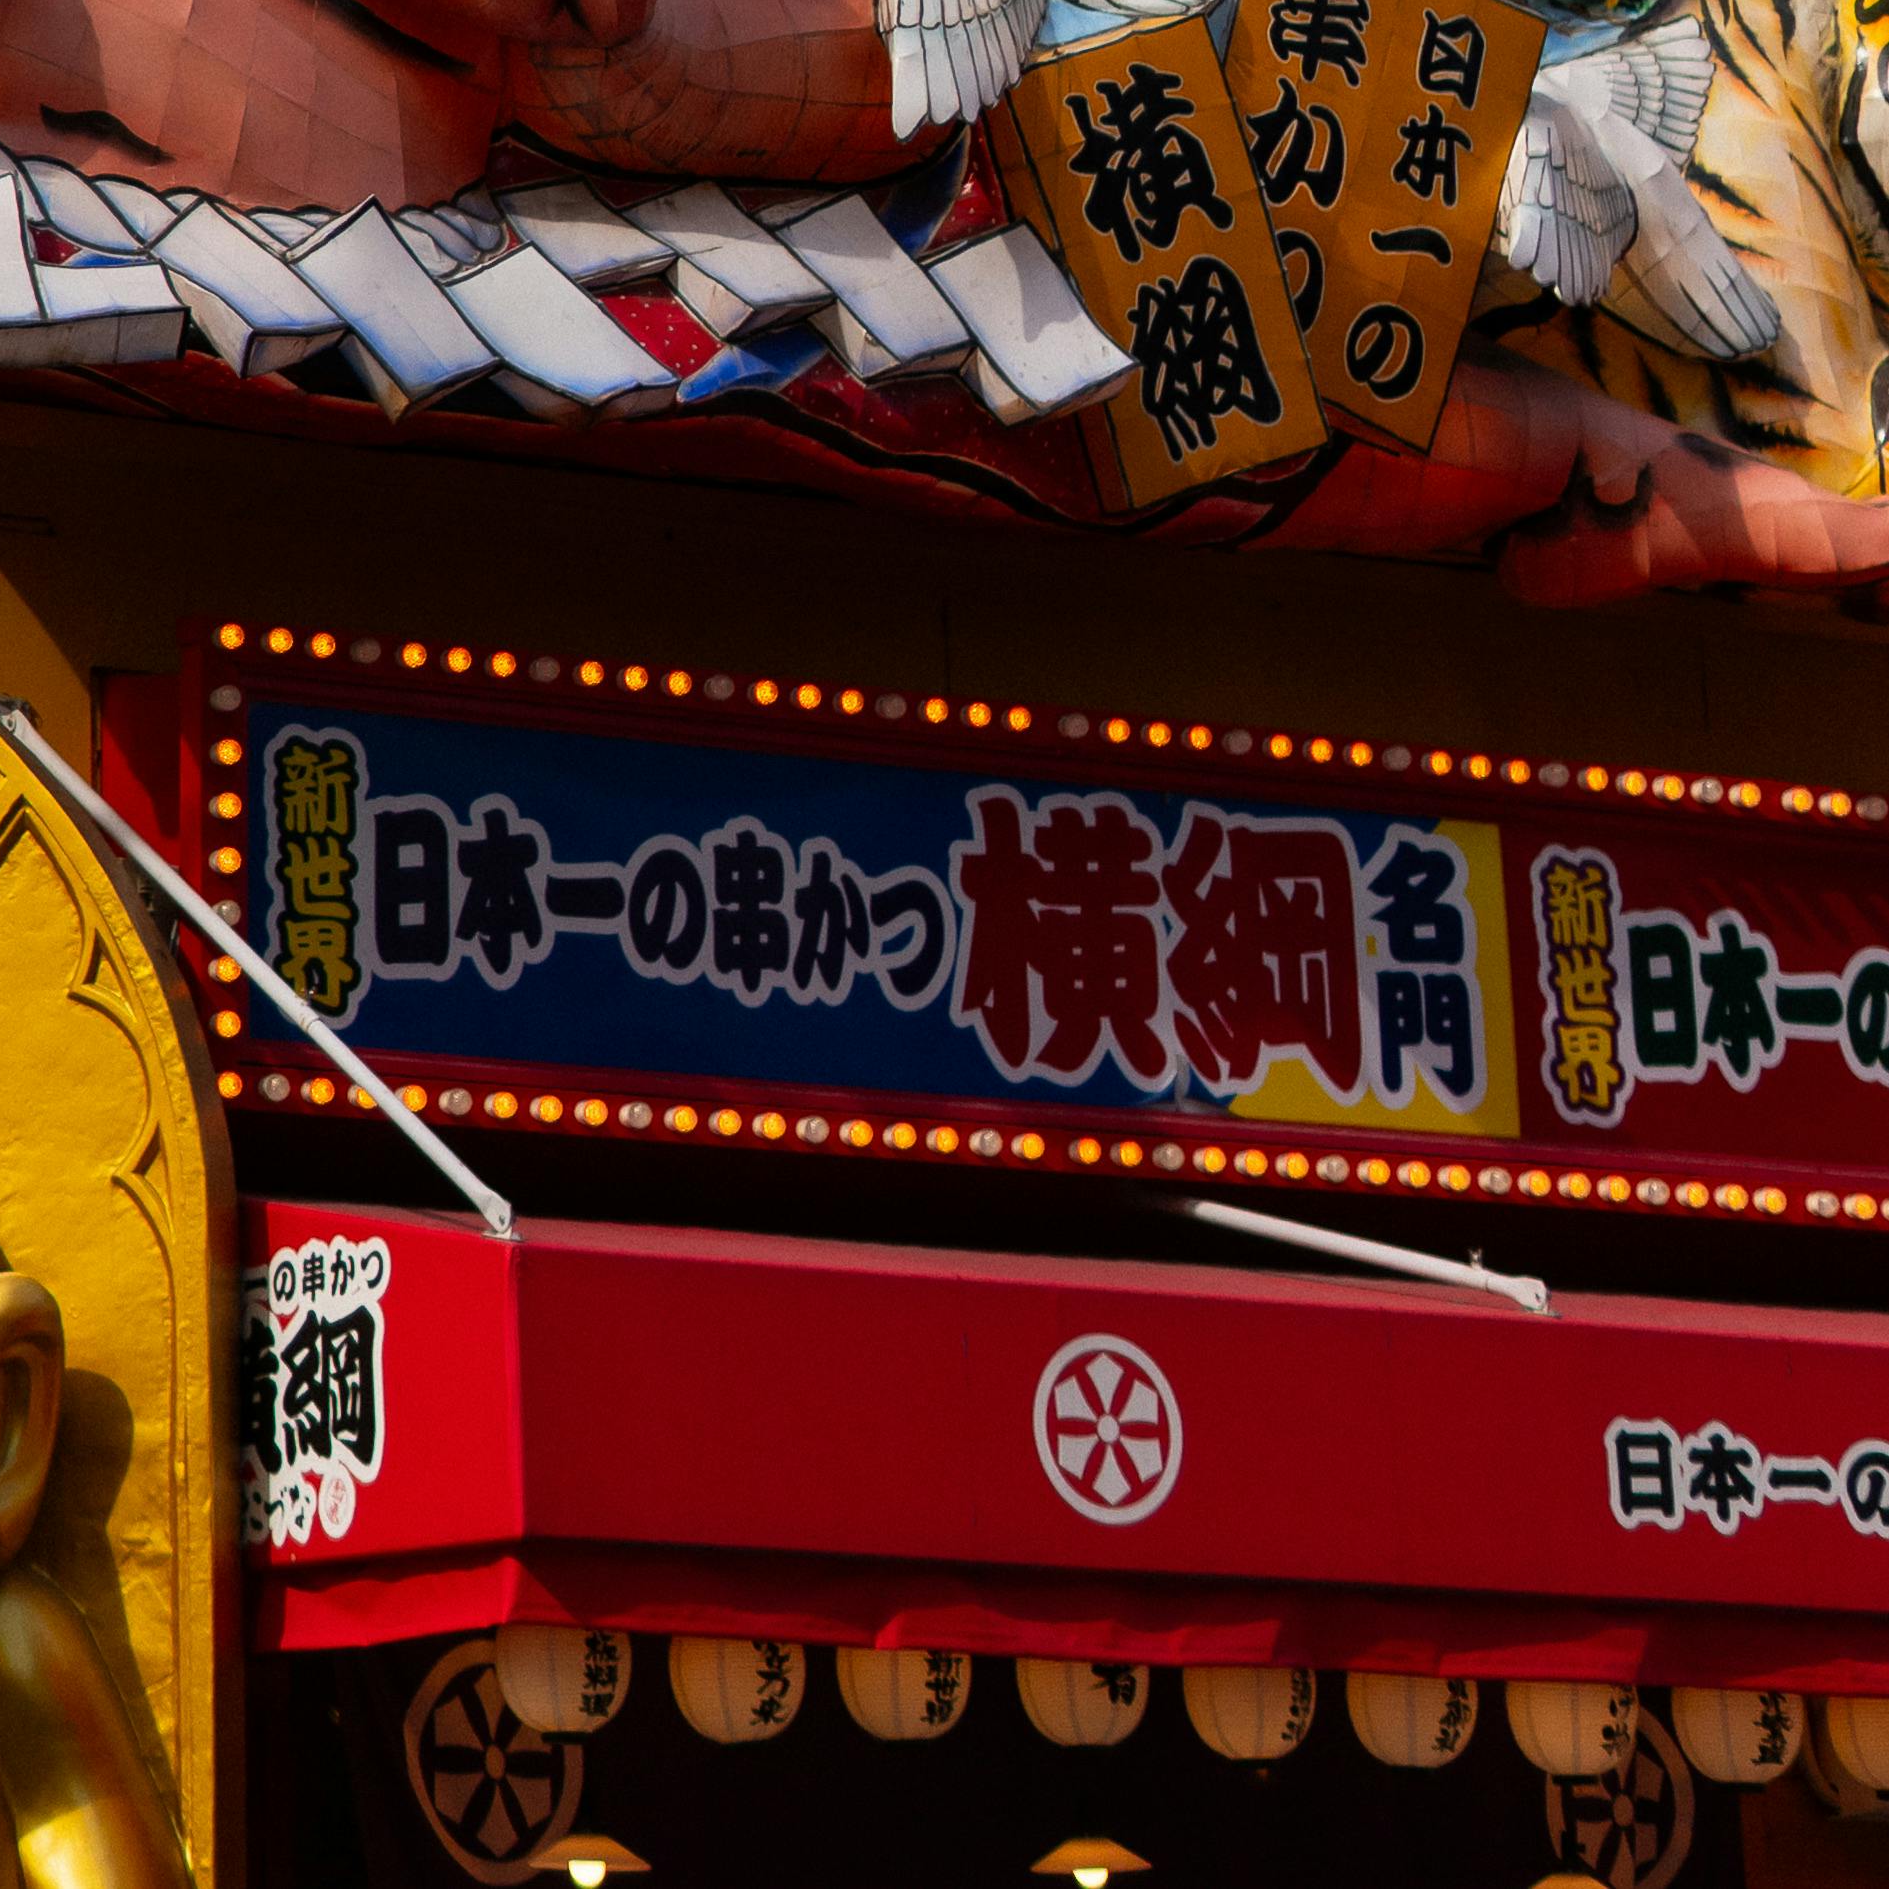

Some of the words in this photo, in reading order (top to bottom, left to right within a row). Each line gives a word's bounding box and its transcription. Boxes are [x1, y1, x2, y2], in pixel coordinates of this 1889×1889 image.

[1344, 7, 1486, 402] 日本一の
[279, 745, 353, 1010] 新世界
[373, 809, 946, 995] 日本一の串かつ
[960, 796, 1360, 1093] 横綱
[1370, 840, 1476, 1097] 名門
[1547, 862, 1618, 1111] 新世界
[1627, 923, 1889, 1082] 日本一の
[1615, 1429, 1889, 1527] 日本一の
